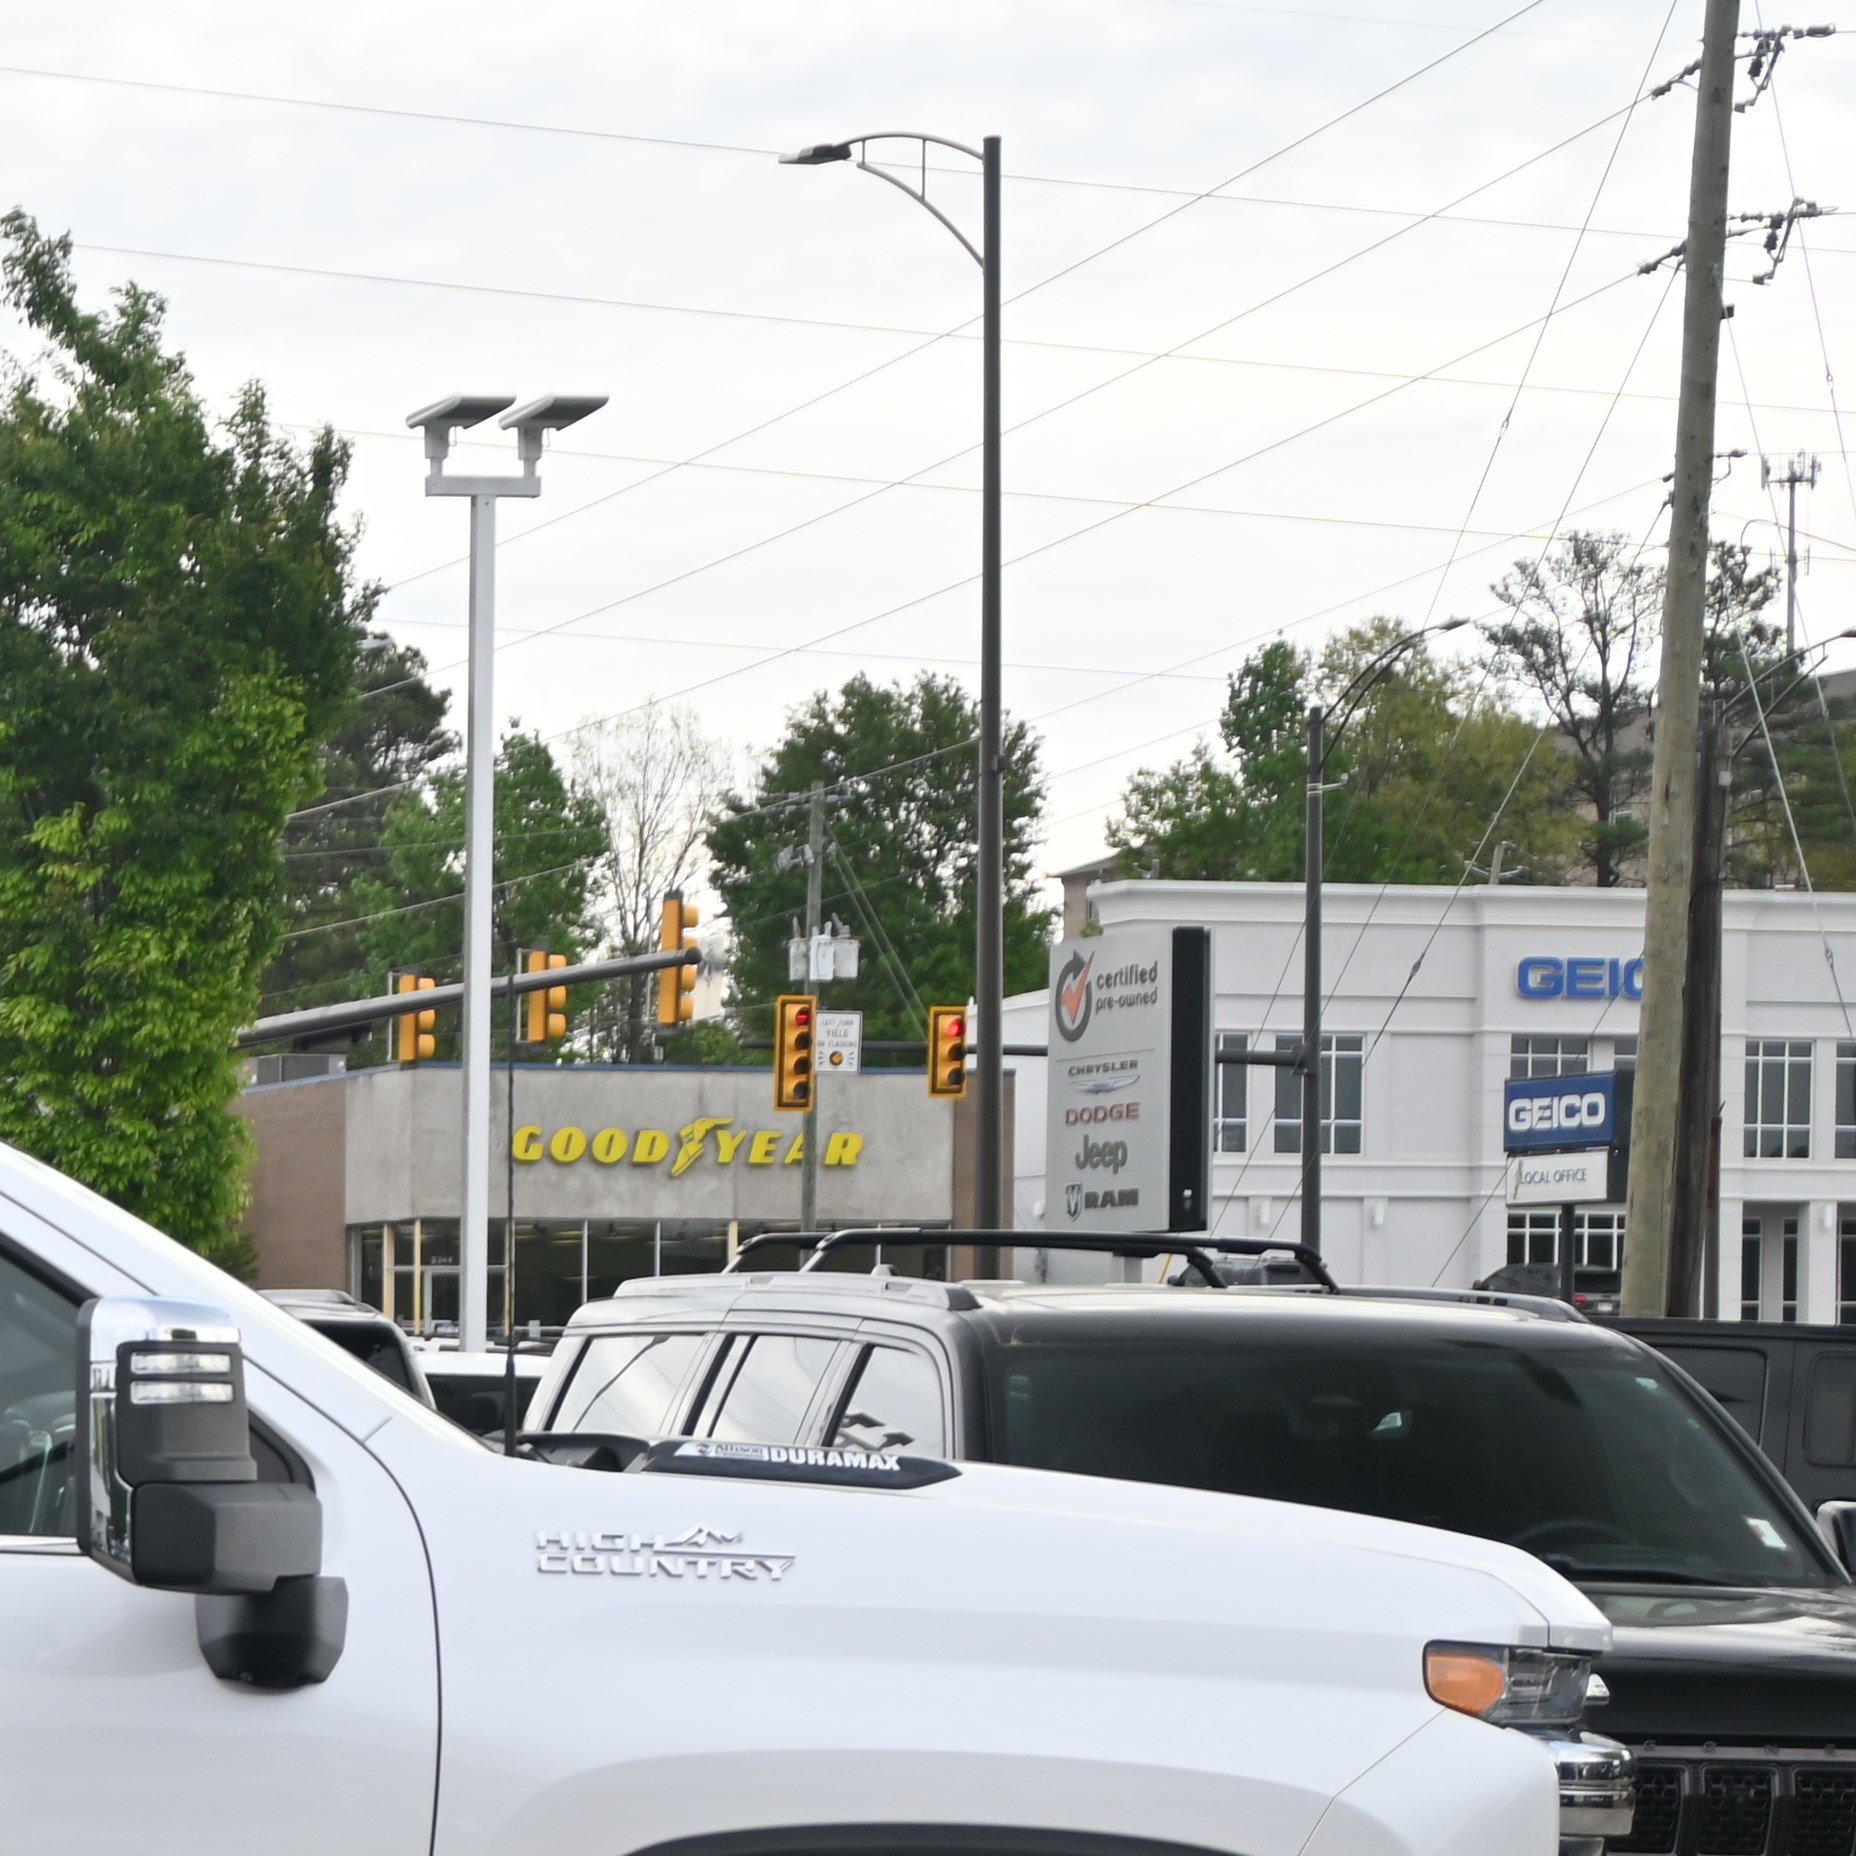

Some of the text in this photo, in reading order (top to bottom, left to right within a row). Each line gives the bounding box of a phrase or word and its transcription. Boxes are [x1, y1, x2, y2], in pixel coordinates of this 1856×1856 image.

[1096, 959, 1158, 989] certified
[1096, 985, 1158, 1015] pre-owned
[1068, 1059, 1139, 1077] CHRYSLER
[1065, 1102, 1140, 1126] DODGE
[1509, 1092, 1605, 1131] GEICO
[512, 1119, 865, 1173] GOODYEAR
[1075, 1133, 1128, 1174] Jeep
[1553, 1168, 1588, 1183] OFFICE
[1084, 1188, 1139, 1209] RAM
[772, 1447, 901, 1471] DURAMAX
[536, 1529, 665, 1553] HIGH
[537, 1553, 796, 1581] COUNTRY
